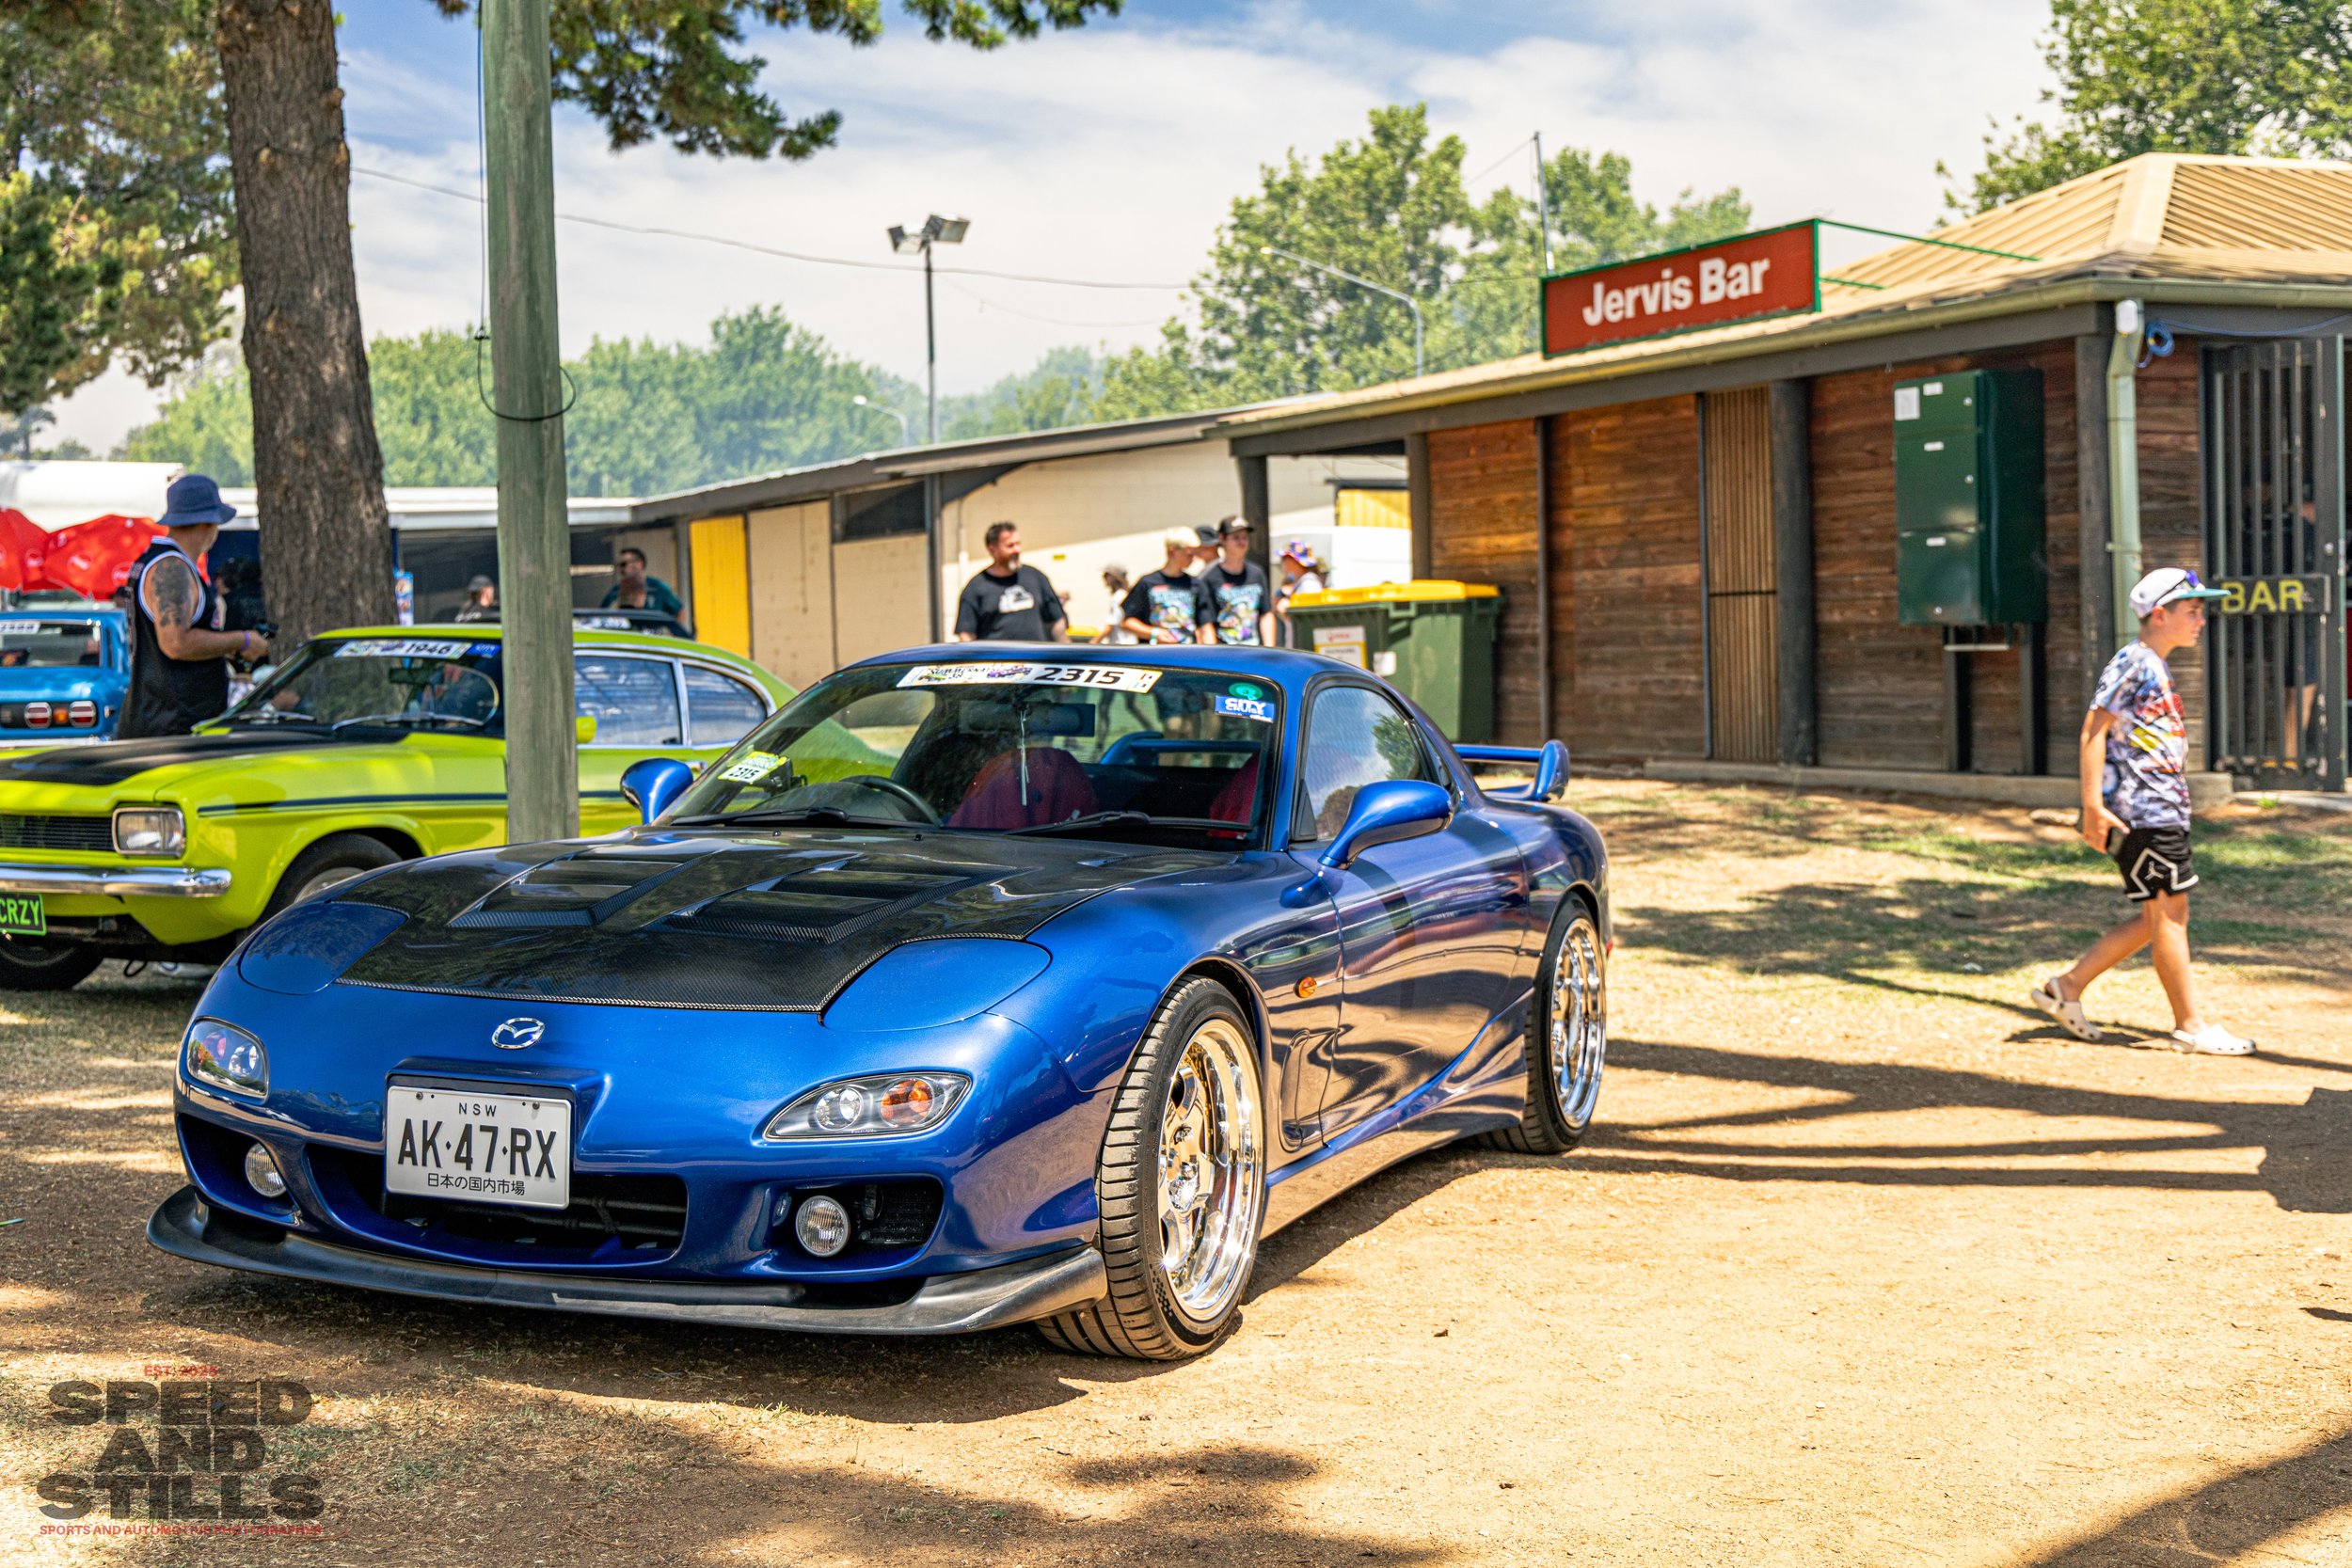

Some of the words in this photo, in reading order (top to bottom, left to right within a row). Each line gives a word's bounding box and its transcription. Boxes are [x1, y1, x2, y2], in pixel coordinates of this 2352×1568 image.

[1581, 268, 1692, 326] Jervis
[1699, 257, 1771, 305] Bar
[2220, 579, 2304, 613] BAR
[1034, 667, 1124, 685] 2315
[728, 767, 759, 779] 2315
[458, 1102, 497, 1117] NSW
[427, 1173, 526, 1196] 日本の国内市場
